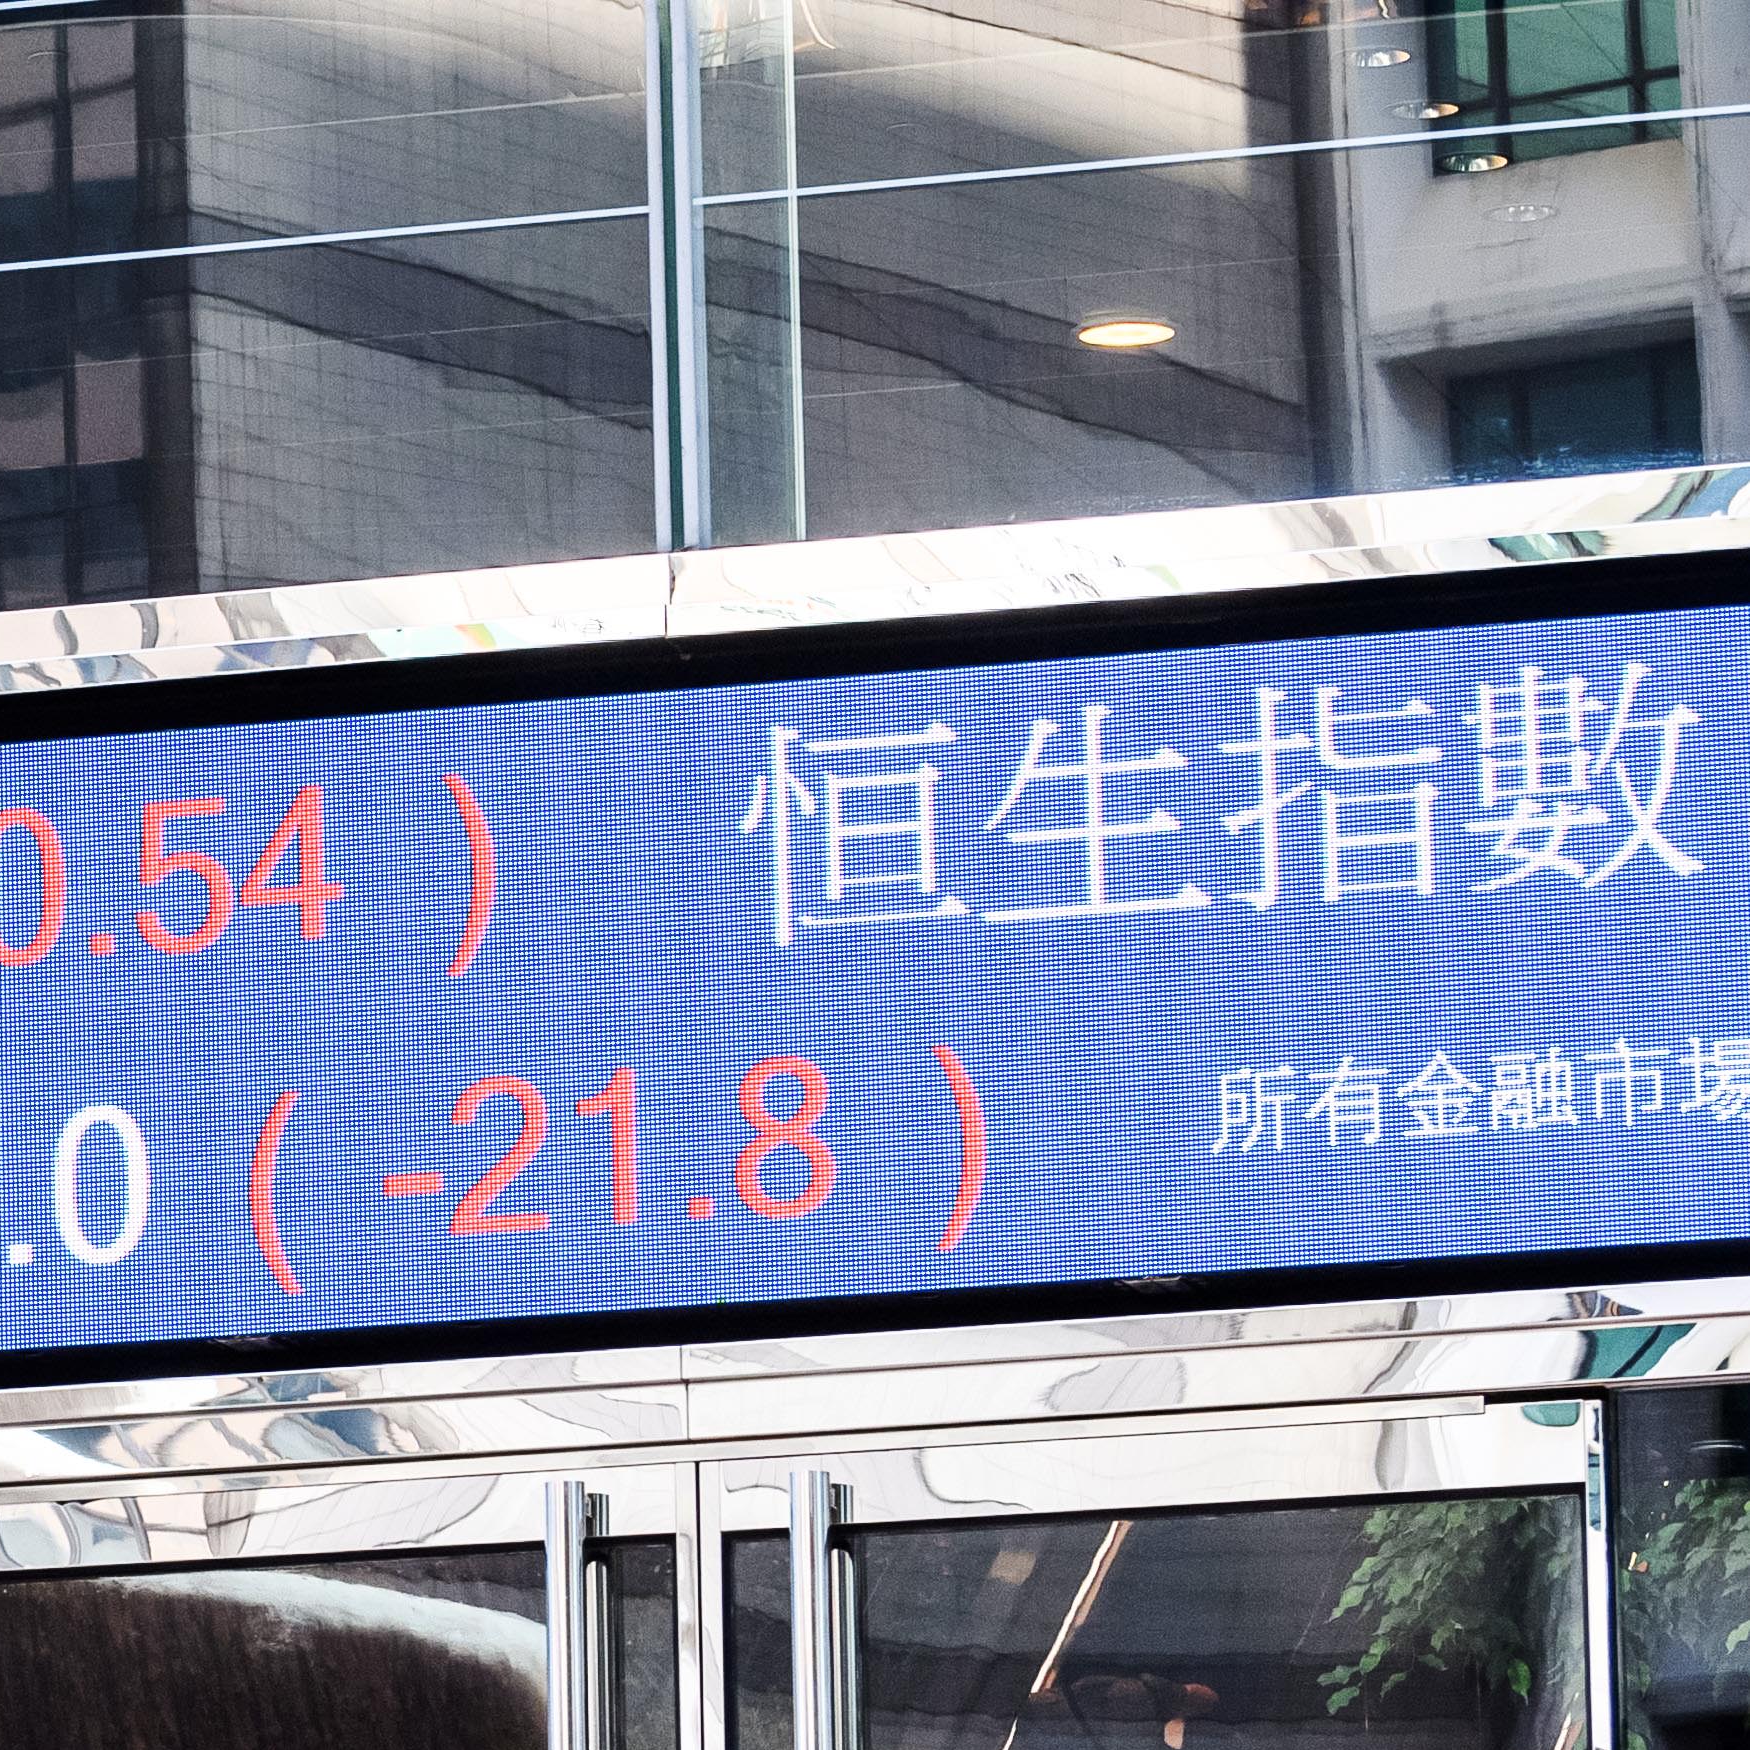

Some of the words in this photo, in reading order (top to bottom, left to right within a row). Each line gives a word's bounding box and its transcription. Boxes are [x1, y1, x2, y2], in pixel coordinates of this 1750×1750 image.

[740, 660, 1706, 948] 恒生指數
[1211, 1036, 1750, 1154] 所有金融市場
